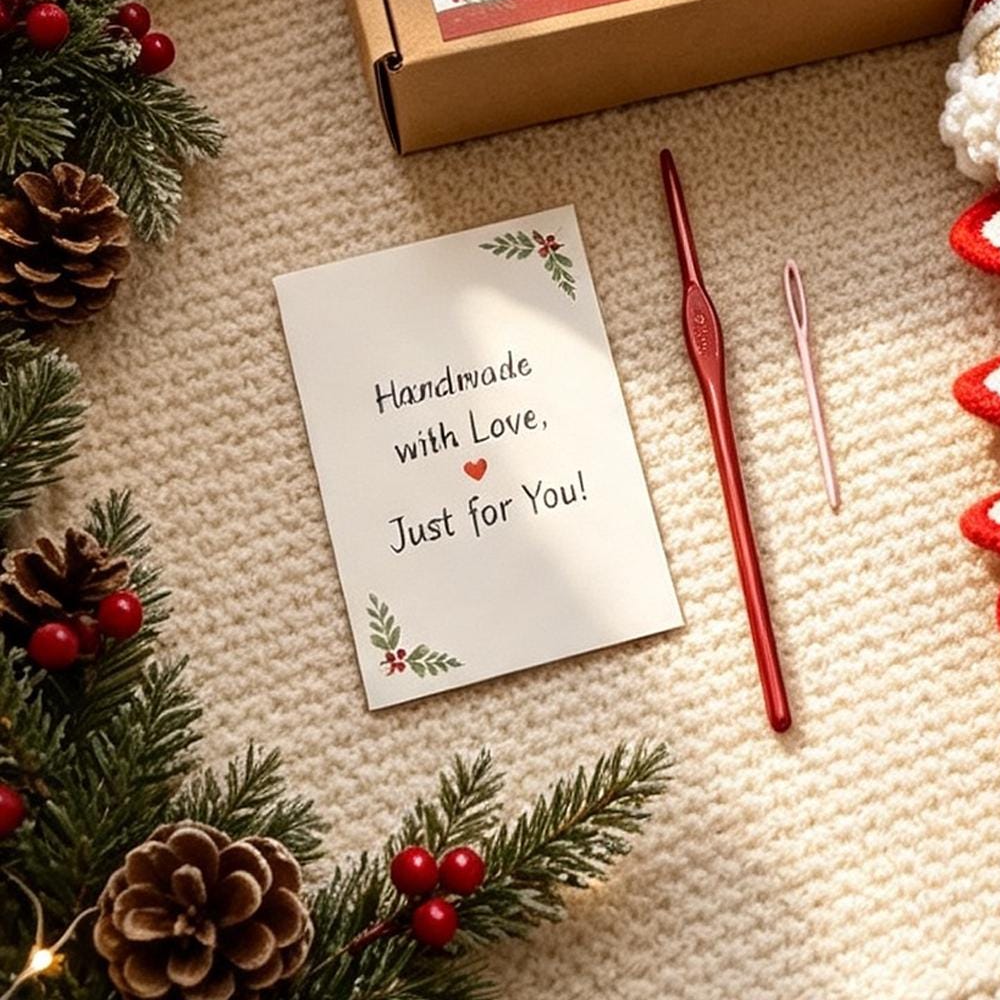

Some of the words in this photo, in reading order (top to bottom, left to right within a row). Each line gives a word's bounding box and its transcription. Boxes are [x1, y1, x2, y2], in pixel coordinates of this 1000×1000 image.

[375, 350, 533, 414] Handmade
[394, 421, 459, 463] with
[468, 409, 547, 443] Love,
[388, 507, 455, 553] Just
[468, 495, 513, 537] for
[521, 470, 588, 515] You!
